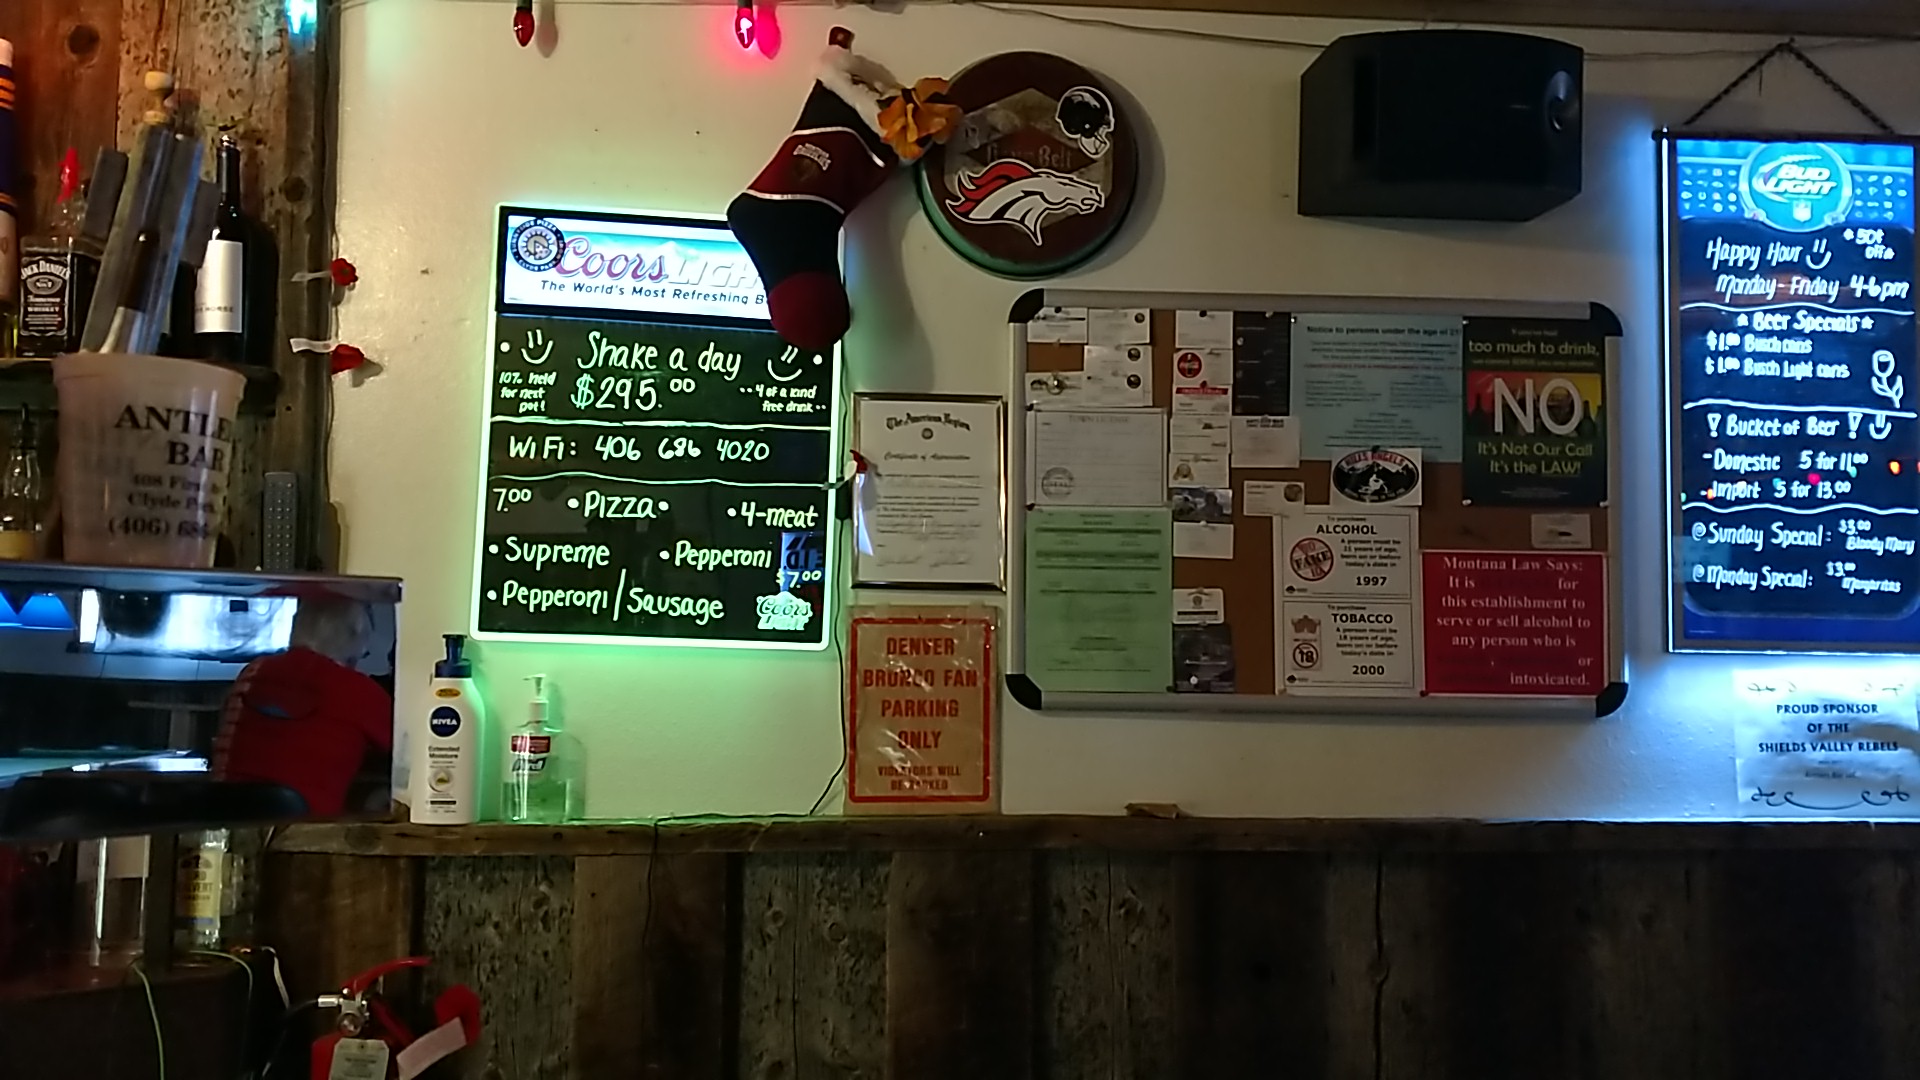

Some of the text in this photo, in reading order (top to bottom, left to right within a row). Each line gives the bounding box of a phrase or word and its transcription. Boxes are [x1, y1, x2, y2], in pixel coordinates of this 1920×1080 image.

[1778, 165, 1830, 180] BUD
[1769, 180, 1837, 194] LIGHT
[554, 237, 669, 281] Coors
[1706, 237, 1803, 270] Happy Hour
[21, 264, 39, 279] JACK
[541, 280, 748, 305] The World's Most Refreshing
[1753, 309, 1860, 333] Beer Specials
[1469, 341, 1492, 352] too
[1497, 340, 1535, 353] much
[1540, 342, 1555, 354] to
[1559, 342, 1600, 356] drink,
[1744, 333, 1782, 353] Busch
[577, 331, 741, 380] Shake a day
[1744, 357, 1780, 376] Busch
[780, 388, 787, 397] a
[790, 385, 817, 398] kind
[762, 400, 784, 412] free
[1493, 377, 1583, 435] NO
[1726, 414, 1840, 436] Bucket of Beer
[167, 440, 225, 472] BAR
[595, 435, 770, 462] 406 686 4020
[1478, 442, 1593, 458] It's Not Our Call
[1489, 460, 1581, 476] It's the LAW!
[1798, 450, 1814, 470] 5
[1816, 453, 1837, 471] for
[1773, 483, 1787, 498] 5
[1790, 482, 1812, 498] for
[584, 491, 818, 528] Pizza 4-meat
[1316, 524, 1378, 535] ALCOHOL
[505, 536, 772, 570] Supreme Pepperoni
[1885, 536, 1915, 555] Mary
[1295, 550, 1331, 569] FAKE
[1443, 556, 1583, 574] Montana Law Says:
[1356, 576, 1387, 586] 1997
[1449, 576, 1459, 588] It
[1465, 577, 1475, 588] is
[1558, 577, 1579, 590] for
[1442, 595, 1585, 609] this establishment to
[1331, 613, 1393, 623] TOBACCO
[1437, 615, 1591, 628] serve or sell alcohol to
[887, 637, 955, 656] DENVER
[1452, 635, 1576, 649] any person who is
[1578, 657, 1594, 666] or
[1352, 665, 1384, 675] 2000
[863, 669, 978, 688] BRONCO FAN
[1510, 672, 1590, 685] intoxicated.
[881, 699, 959, 718] PARKING
[1776, 704, 1879, 714] PROUD SPONSOR
[1807, 723, 1849, 733] OF THE
[898, 731, 941, 749] ONLY
[1759, 741, 1898, 752] SHIELDS VALLEY REBELS
[938, 766, 961, 776] WILL
